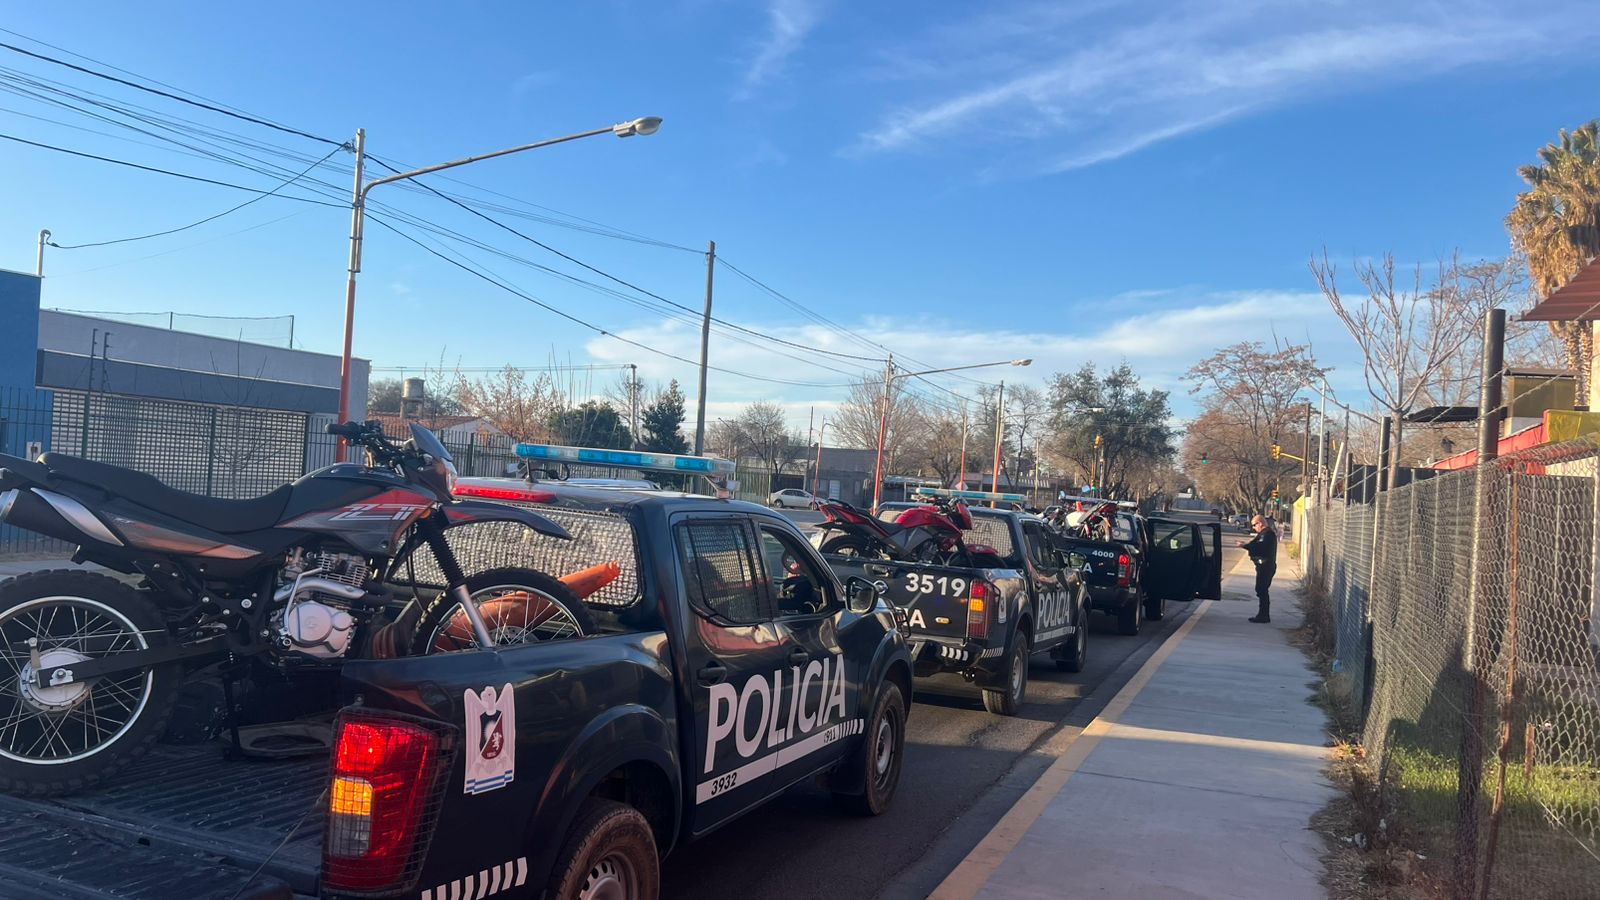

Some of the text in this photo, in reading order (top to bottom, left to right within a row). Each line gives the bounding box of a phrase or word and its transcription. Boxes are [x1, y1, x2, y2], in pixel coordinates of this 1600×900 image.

[1092, 550, 1114, 558] 4000
[905, 573, 966, 597] 3519
[1037, 591, 1070, 630] POLICIA
[704, 653, 846, 774] POLICIA
[711, 772, 737, 796] 3932
